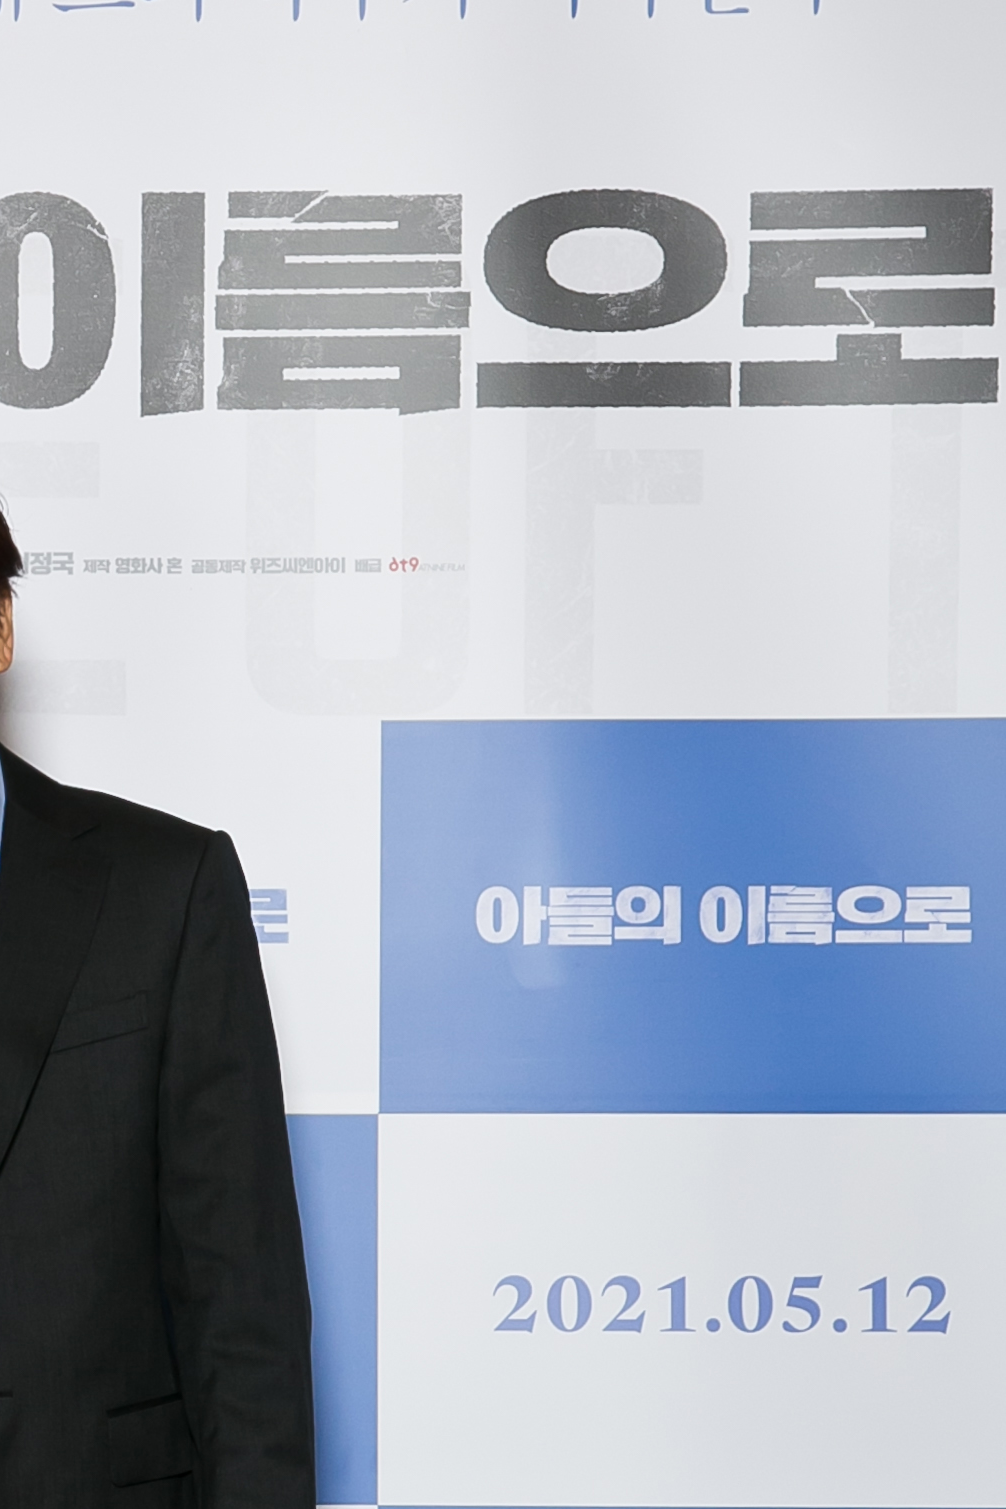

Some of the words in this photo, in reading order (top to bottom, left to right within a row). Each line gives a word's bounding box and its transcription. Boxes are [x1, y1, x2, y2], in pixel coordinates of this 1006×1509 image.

[83, 560, 112, 574] 제작
[115, 558, 163, 575] 영화사
[167, 557, 183, 575] 혼
[191, 560, 247, 575] 공동제작
[250, 557, 346, 575] 위즈씨엔아이
[355, 559, 382, 573] 배급
[475, 884, 682, 946] 아들의
[699, 885, 972, 946] 이름으로
[492, 1275, 951, 1335] 2021.05.12
